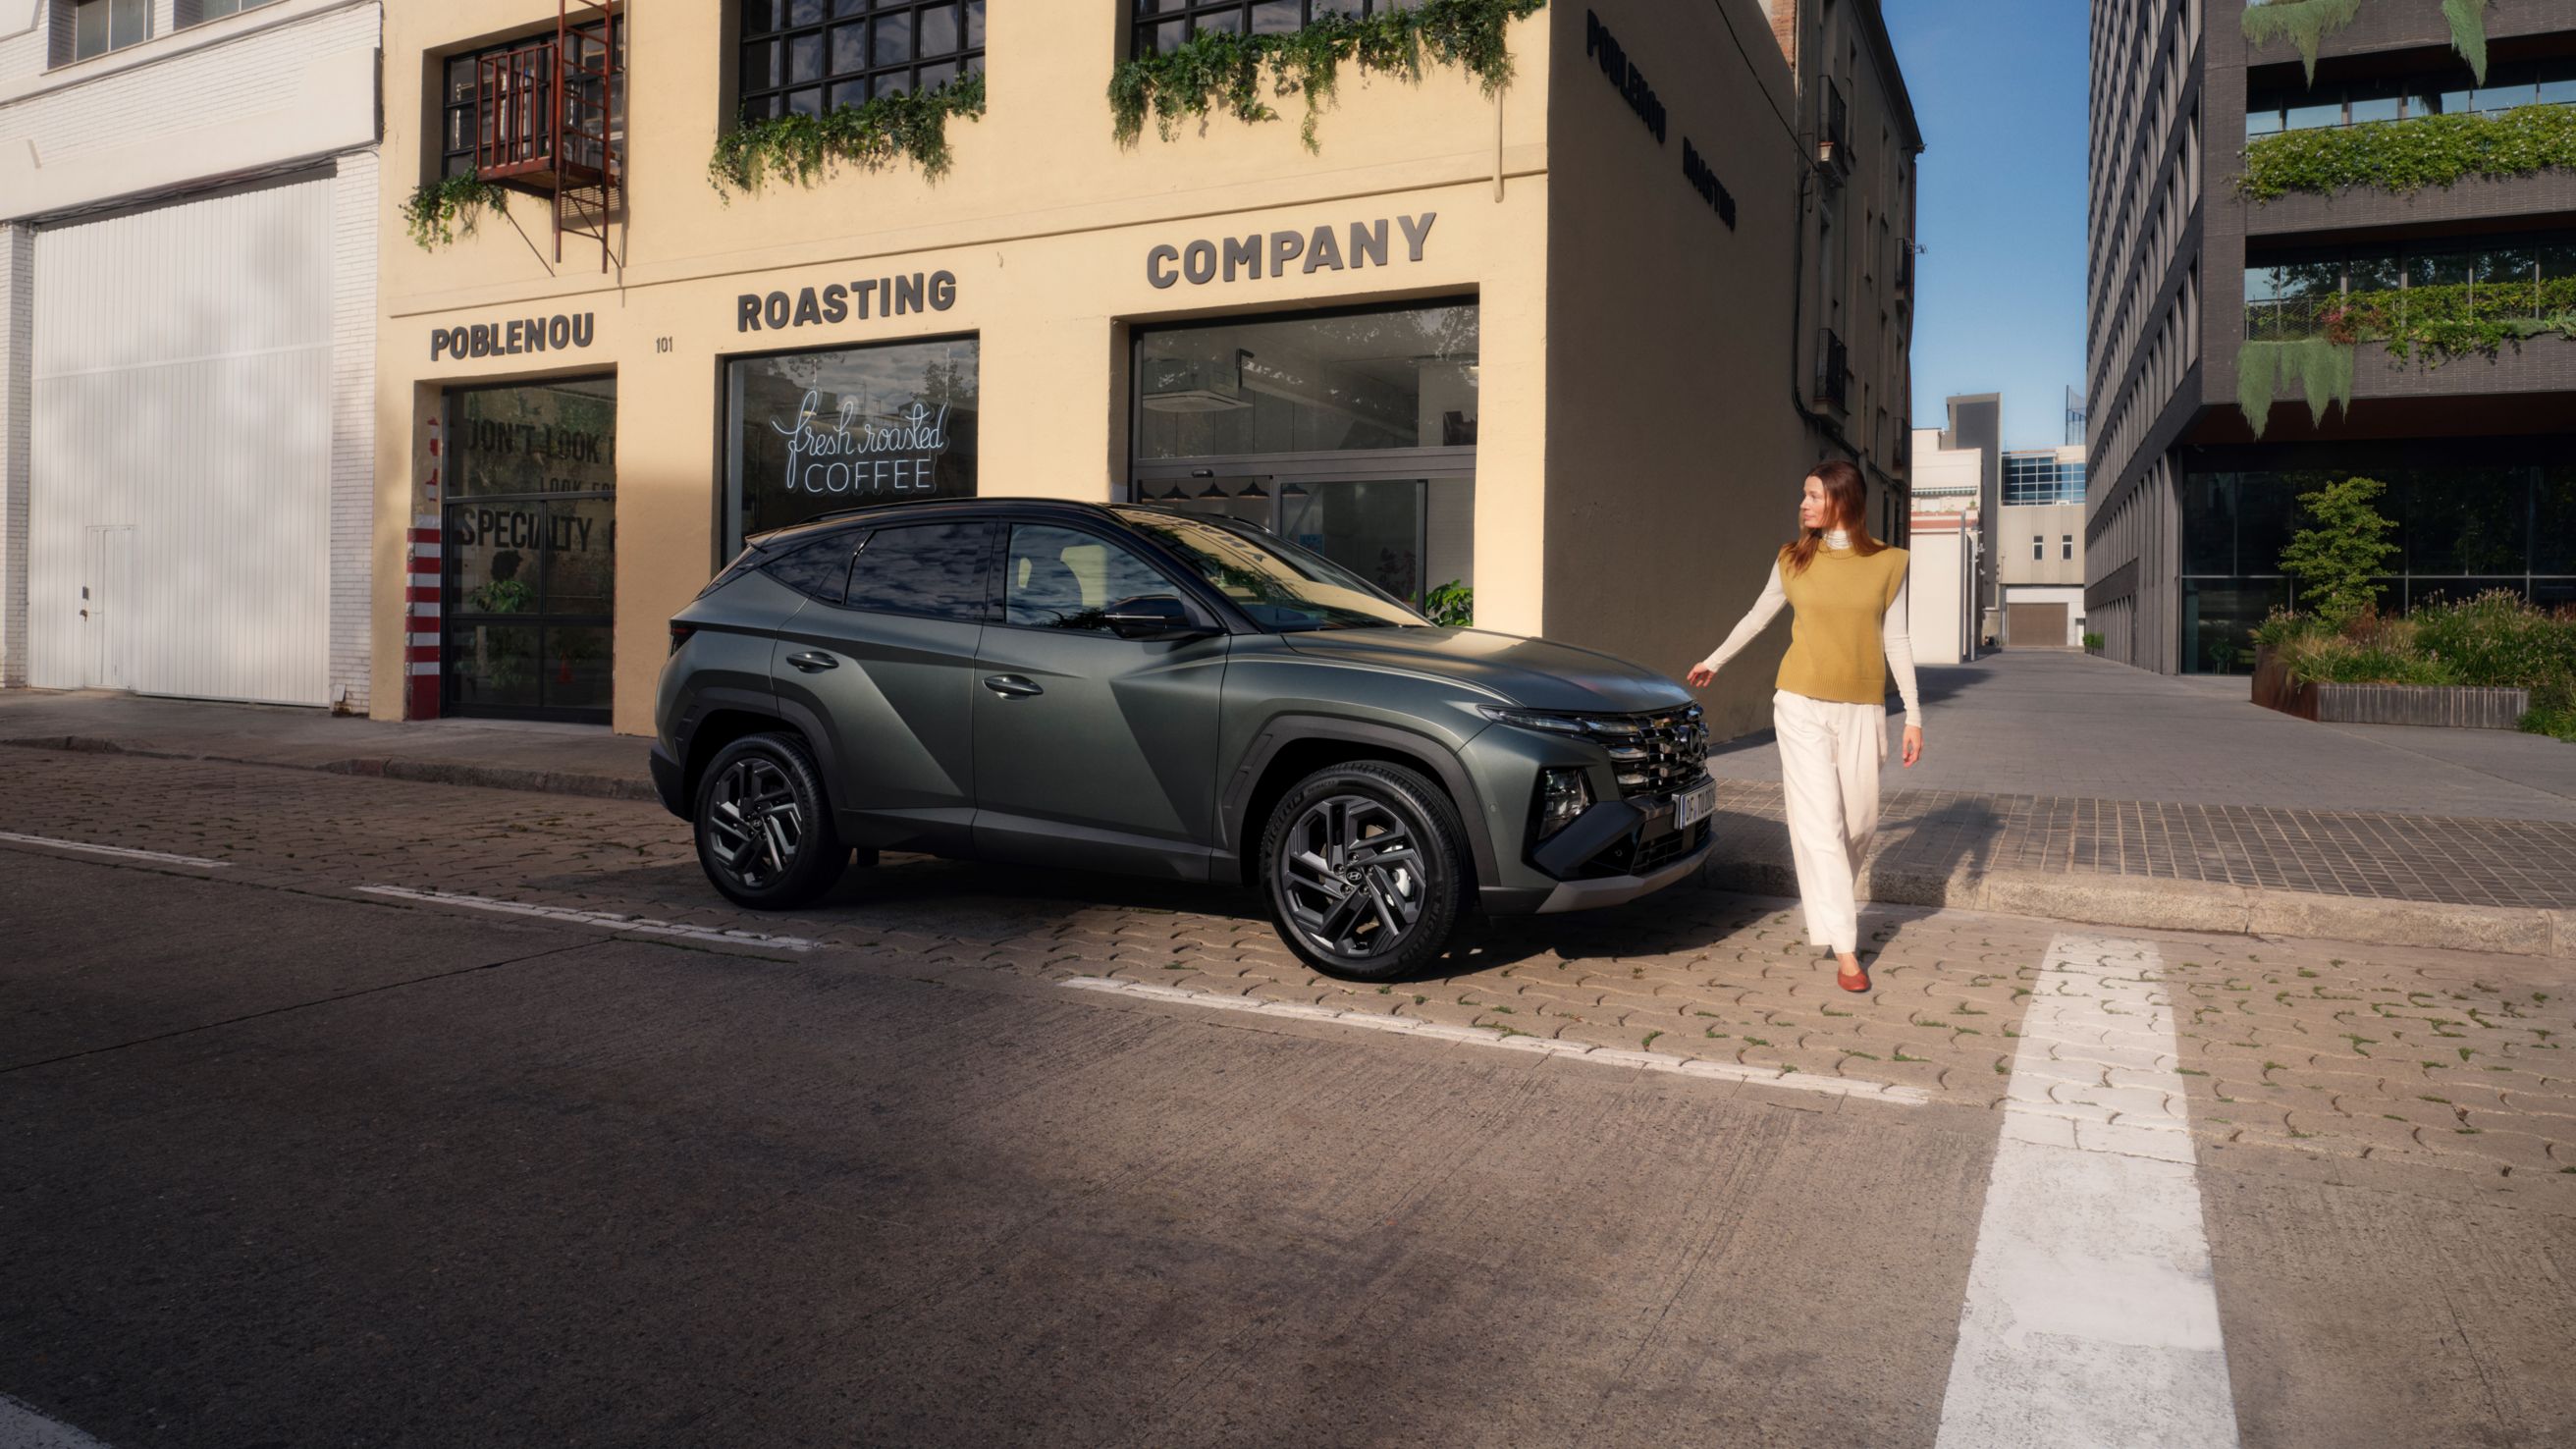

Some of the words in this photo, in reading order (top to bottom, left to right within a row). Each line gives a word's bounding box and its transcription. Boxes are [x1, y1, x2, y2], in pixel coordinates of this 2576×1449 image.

[430, 312, 595, 362] POBLENOU
[737, 269, 957, 333] ROASTING
[1147, 212, 1437, 289] COMPANY
[656, 336, 673, 354] 101
[772, 390, 854, 489] fresh
[858, 402, 947, 455] roasted
[805, 458, 932, 492] COFFEE
[460, 508, 593, 553] SPECIALTY
